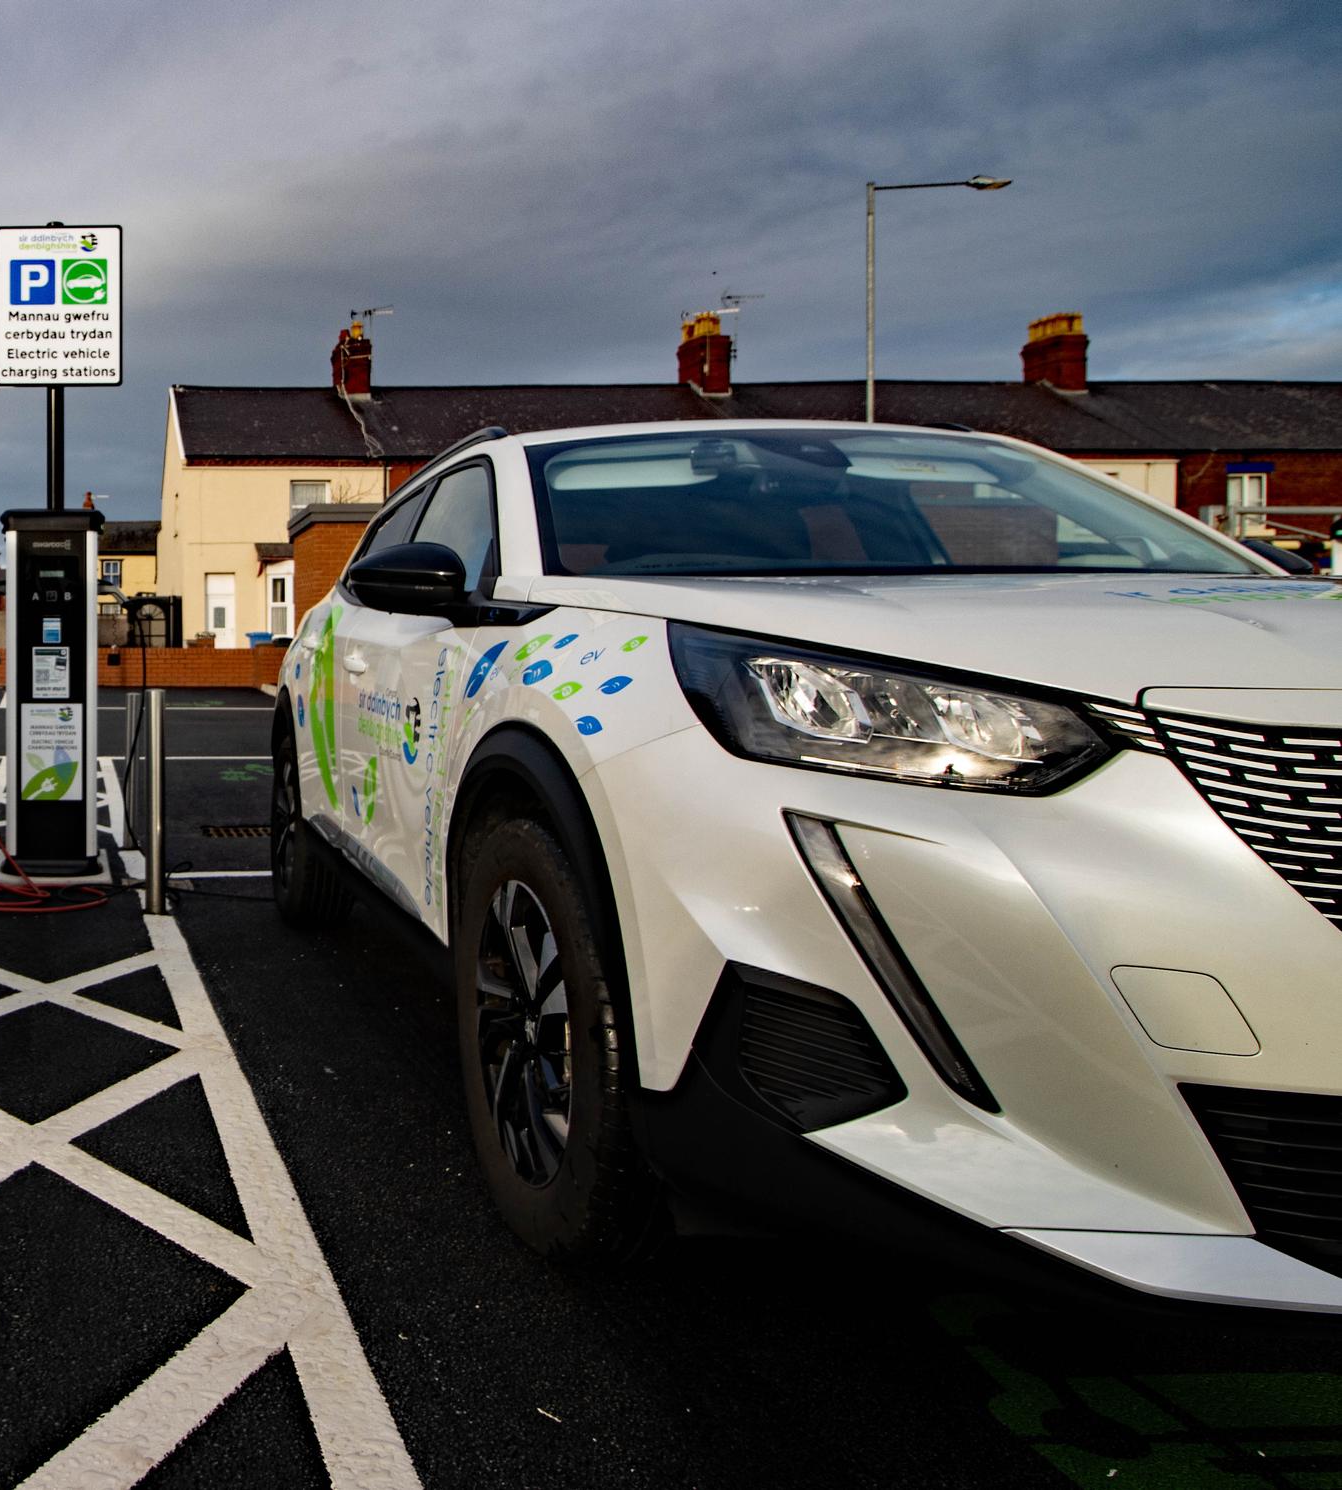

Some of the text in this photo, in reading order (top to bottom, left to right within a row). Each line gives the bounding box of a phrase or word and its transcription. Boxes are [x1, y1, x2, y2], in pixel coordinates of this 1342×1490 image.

[20, 264, 49, 301] P
[8, 310, 109, 323] Mannau gwefru
[5, 329, 113, 341] cerbydau trydan
[7, 348, 110, 359] Electric vehicle
[1, 366, 116, 379] charging stations
[580, 647, 607, 666] ev
[424, 786, 433, 906] vehicle
